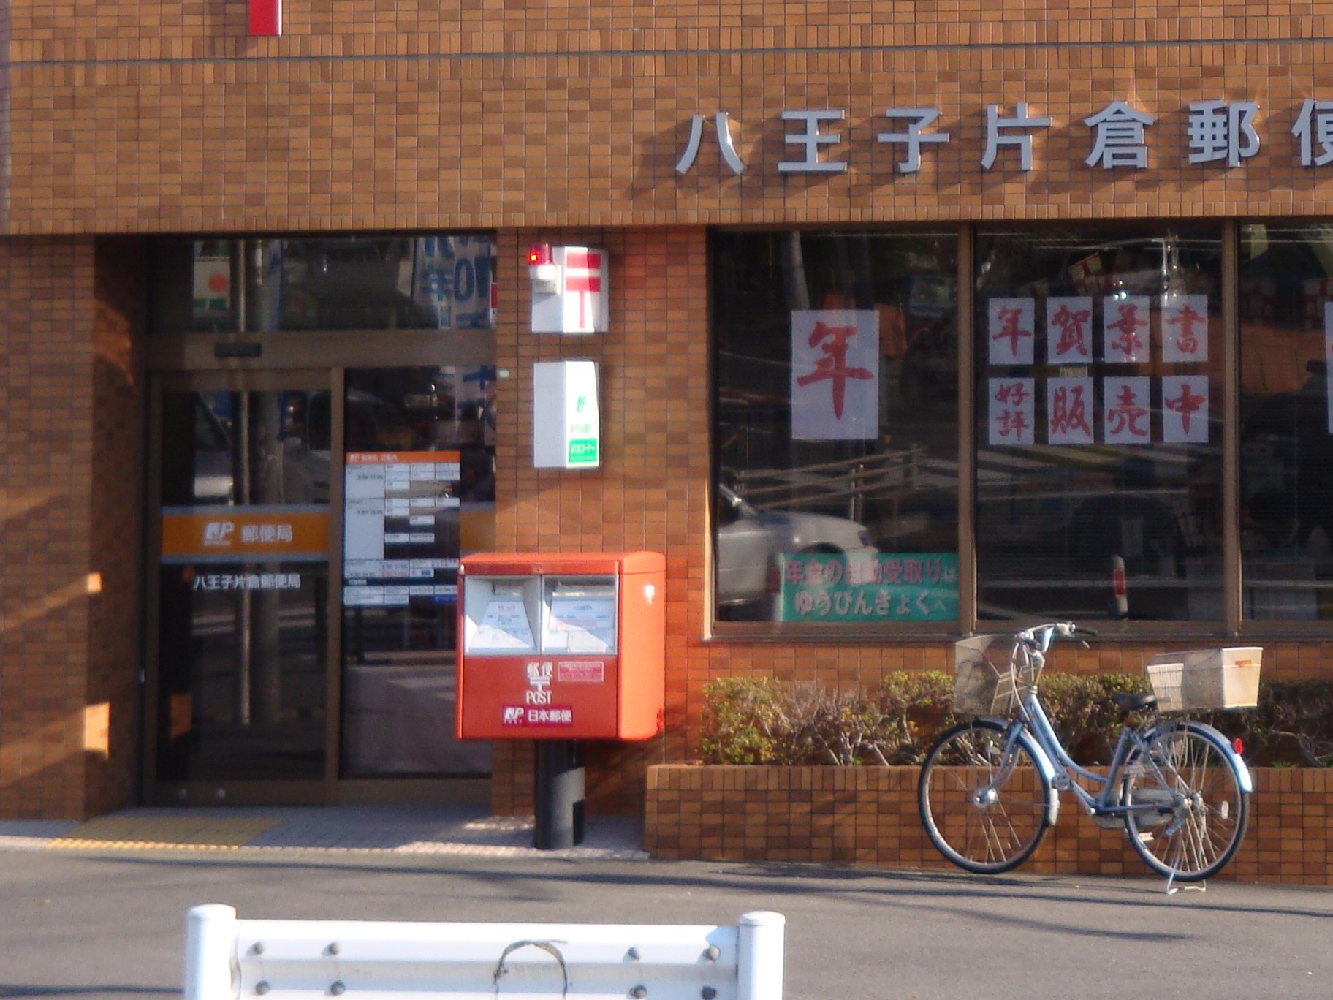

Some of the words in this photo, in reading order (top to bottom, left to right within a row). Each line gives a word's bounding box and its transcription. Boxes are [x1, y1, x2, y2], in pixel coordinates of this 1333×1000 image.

[796, 320, 875, 421] 年
[242, 524, 293, 542] 郵便局
[525, 690, 553, 705] POST
